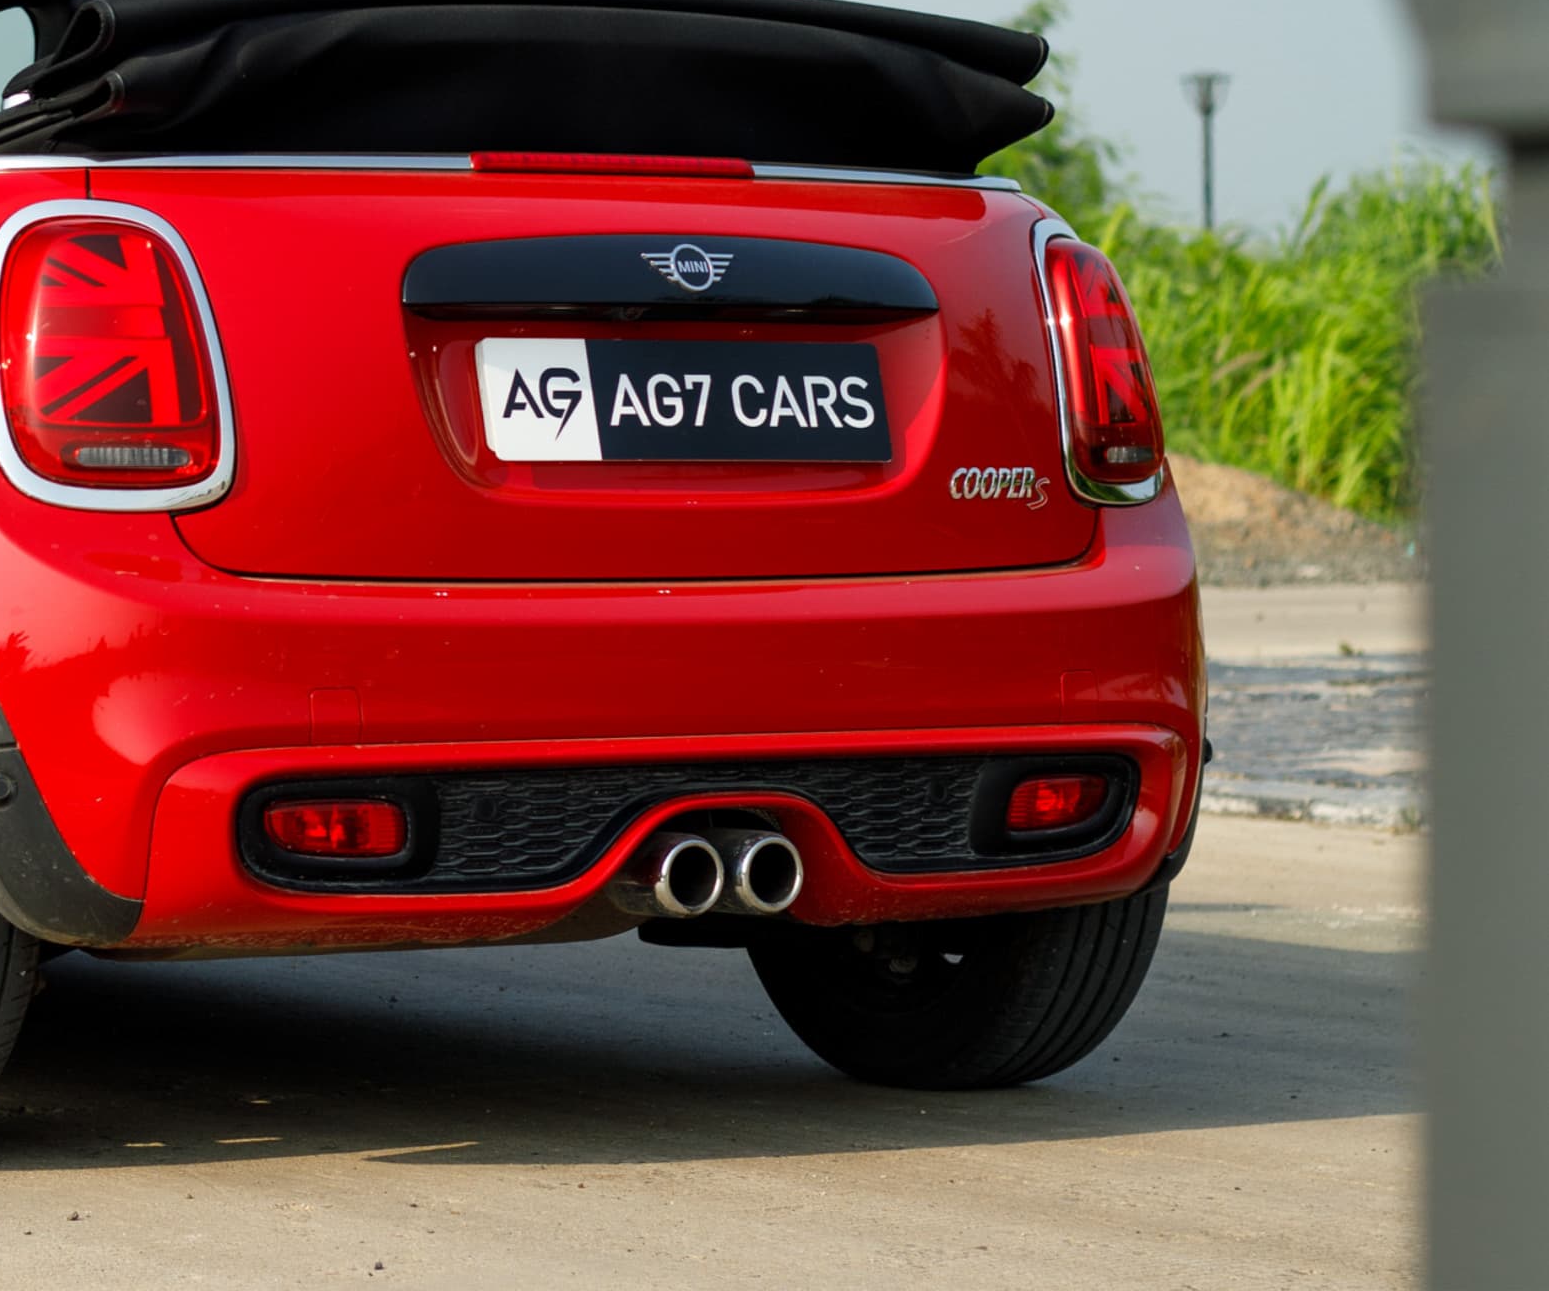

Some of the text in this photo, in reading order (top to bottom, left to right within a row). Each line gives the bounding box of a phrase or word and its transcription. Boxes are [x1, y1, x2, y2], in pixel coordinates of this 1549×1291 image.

[677, 260, 709, 273] MINI
[610, 373, 875, 429] AG7 CARS
[949, 466, 1035, 499] COOPER
